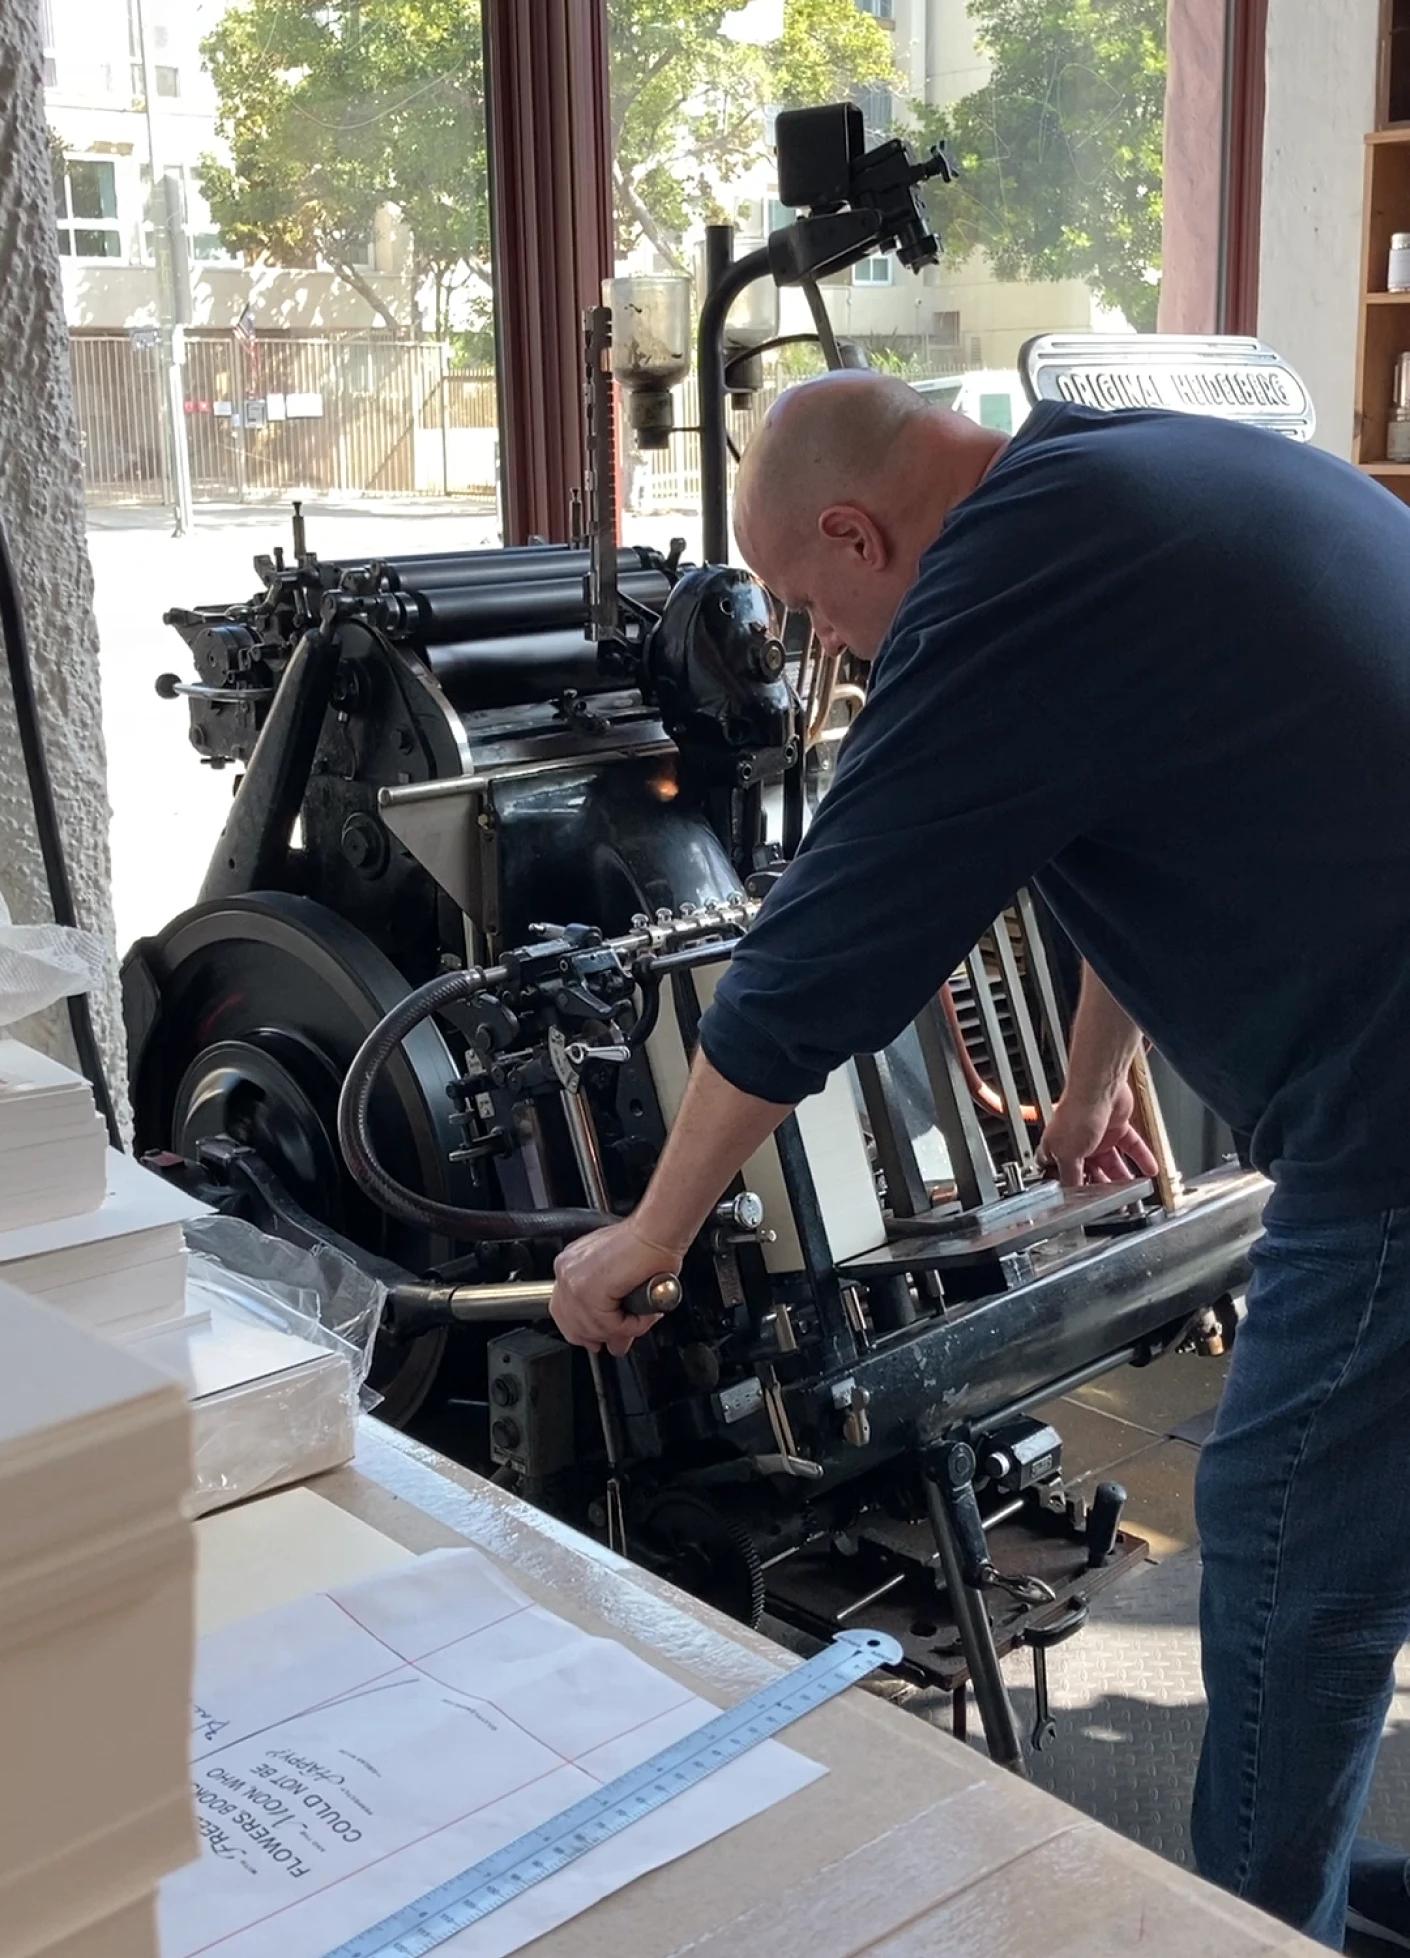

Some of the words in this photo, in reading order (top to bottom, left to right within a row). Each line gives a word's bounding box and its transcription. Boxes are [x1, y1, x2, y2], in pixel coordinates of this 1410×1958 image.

[1056, 373, 1165, 410] ORIGINAL
[1171, 373, 1290, 407] HEIDELBERG
[206, 1768, 247, 1792] WHO
[249, 1763, 278, 1779] BE
[269, 1775, 309, 1795] NOT
[303, 1794, 362, 1843] COULD
